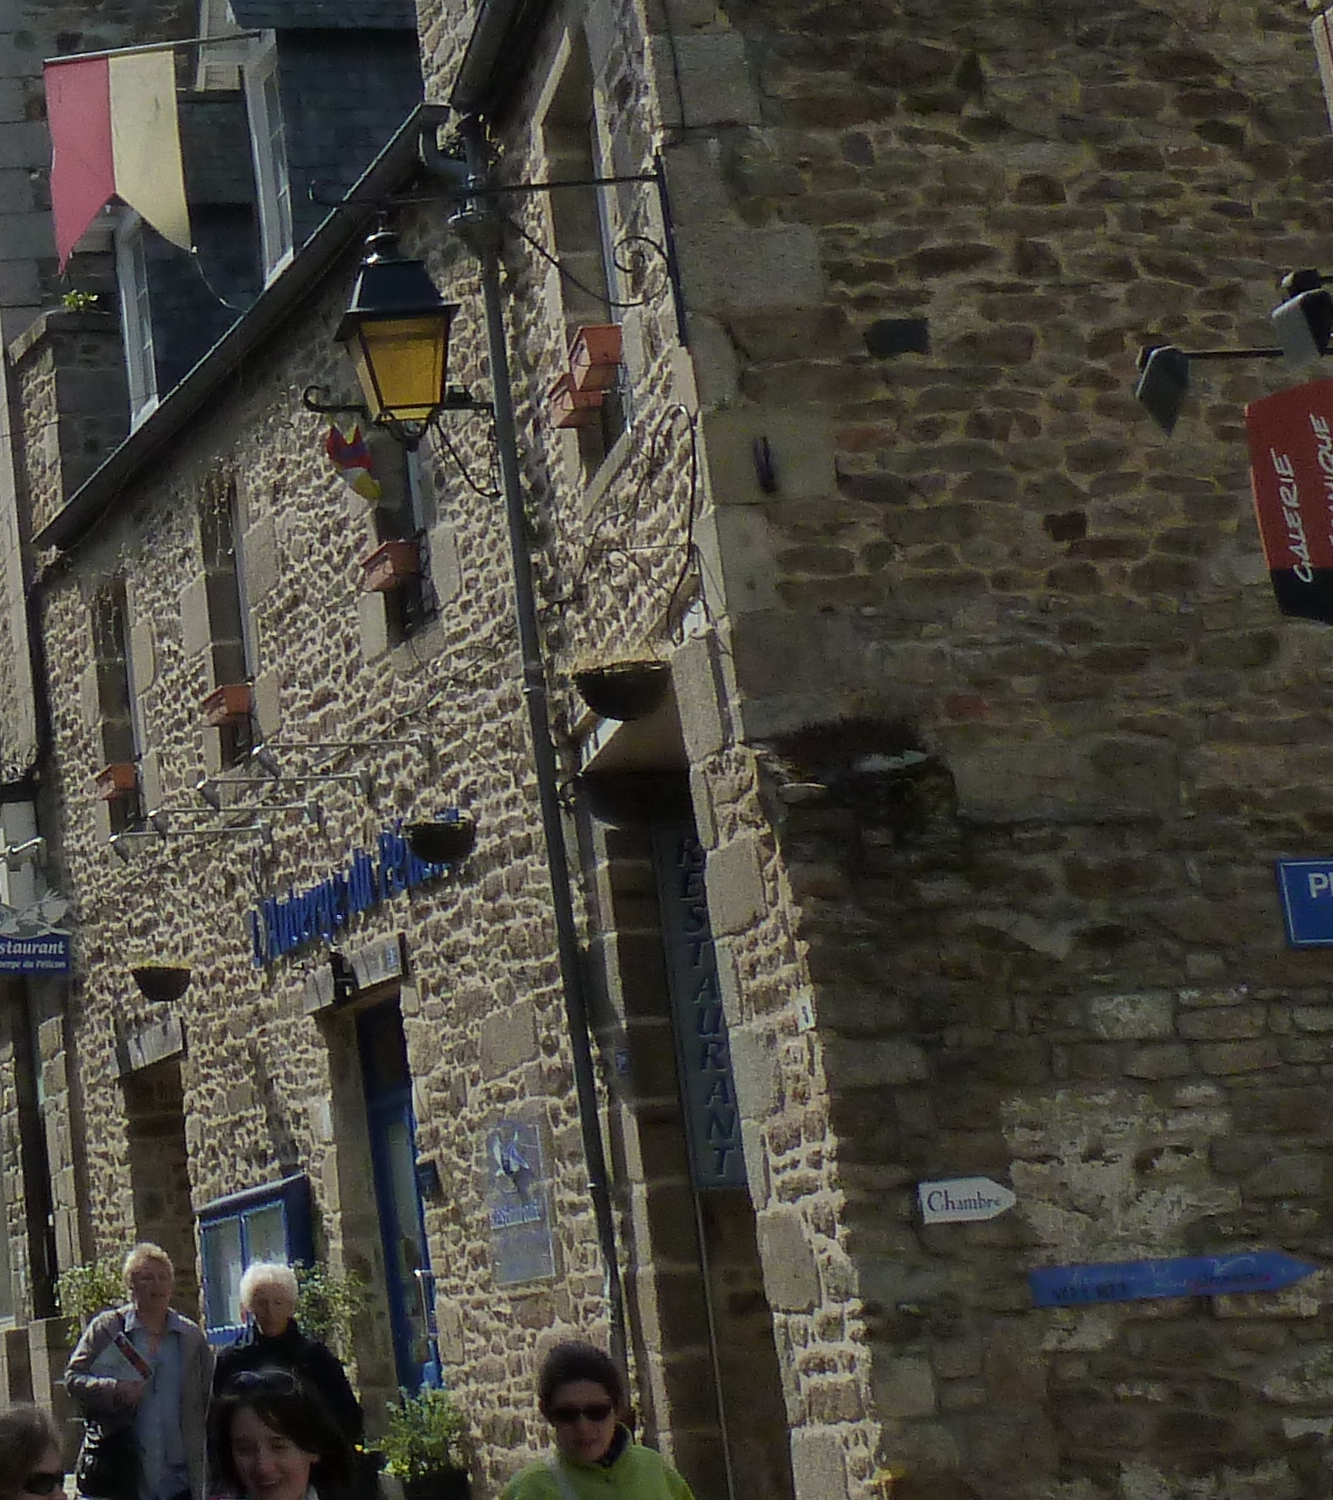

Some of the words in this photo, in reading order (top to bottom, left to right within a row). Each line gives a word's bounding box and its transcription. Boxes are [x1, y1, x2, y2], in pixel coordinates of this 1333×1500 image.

[1270, 447, 1314, 583] GALERIE
[678, 838, 737, 1178] RESTAURANT
[927, 1189, 1002, 1212] Chambre
